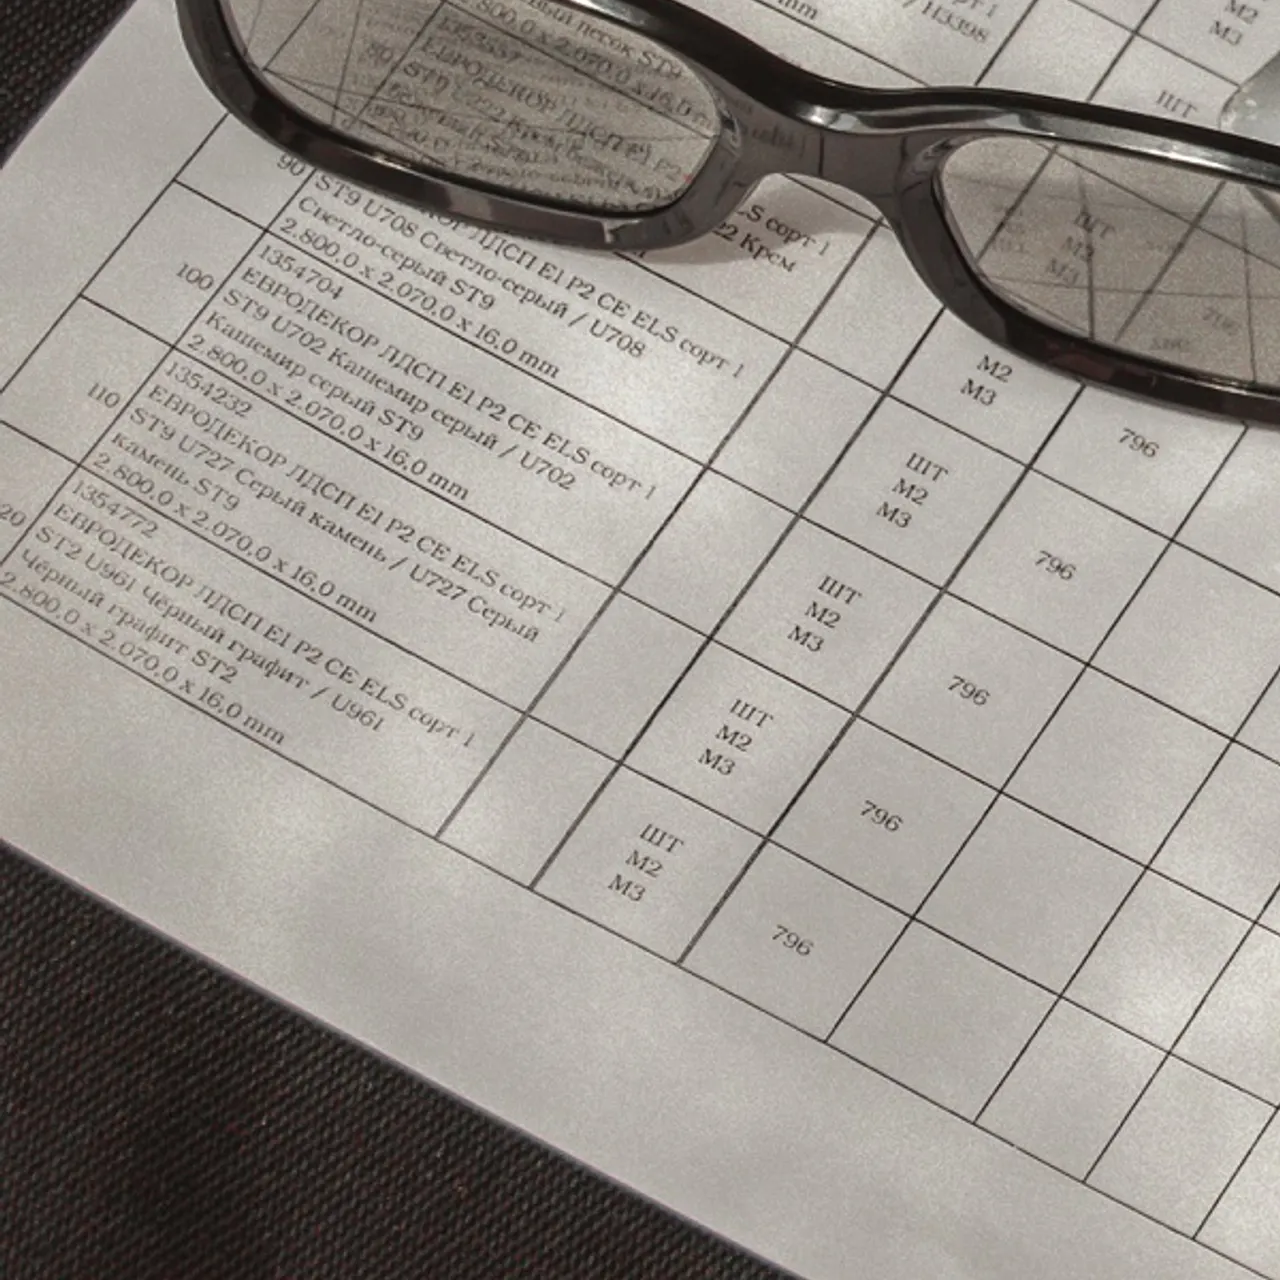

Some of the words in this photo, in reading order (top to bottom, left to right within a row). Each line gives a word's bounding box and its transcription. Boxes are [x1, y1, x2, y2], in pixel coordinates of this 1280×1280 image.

[174, 261, 214, 291] 100
[258, 244, 344, 301] 1354704
[297, 195, 448, 287] Светло-серый
[447, 277, 497, 311] ST9
[313, 174, 361, 207] ST9
[418, 229, 569, 320] Светло-серый
[587, 317, 647, 359] U708
[86, 381, 121, 409] 110
[164, 361, 253, 419] 1354232
[204, 310, 307, 379] Кашемир
[306, 372, 376, 417] серый
[376, 407, 425, 442] ST9
[222, 288, 270, 321] ST9
[270, 314, 327, 356] U702
[325, 346, 430, 415] Кашемир
[429, 407, 499, 451] серый
[518, 448, 577, 491] U702
[240, 266, 380, 349] ЕВРОДЕКОР
[376, 343, 448, 390] ЛДСП
[445, 380, 476, 406] E1
[474, 394, 507, 422] P2
[506, 412, 542, 440] CE
[540, 430, 591, 465] ELS
[589, 459, 643, 492] сорт
[110, 431, 190, 486] камень
[191, 476, 241, 512] ST9
[426, 470, 469, 501] mm
[71, 479, 159, 539] 1354772
[128, 406, 177, 441] ST9
[177, 432, 236, 472] U727
[233, 466, 307, 518] Серый
[307, 510, 387, 563] камень
[407, 562, 469, 601] U727
[466, 594, 540, 644] Серый
[802, 599, 842, 629] М2
[816, 573, 863, 606] ШТ
[34, 525, 83, 561] ST2
[83, 551, 137, 593] U961
[225, 638, 311, 689] графит
[329, 692, 385, 732] U961
[105, 602, 190, 655] графит
[190, 647, 239, 685] ST2
[785, 623, 825, 653] М3
[946, 673, 992, 707] 796
[623, 848, 664, 879] М2
[638, 822, 685, 854] ШТ
[606, 872, 647, 902] М3
[770, 922, 815, 957] 796
